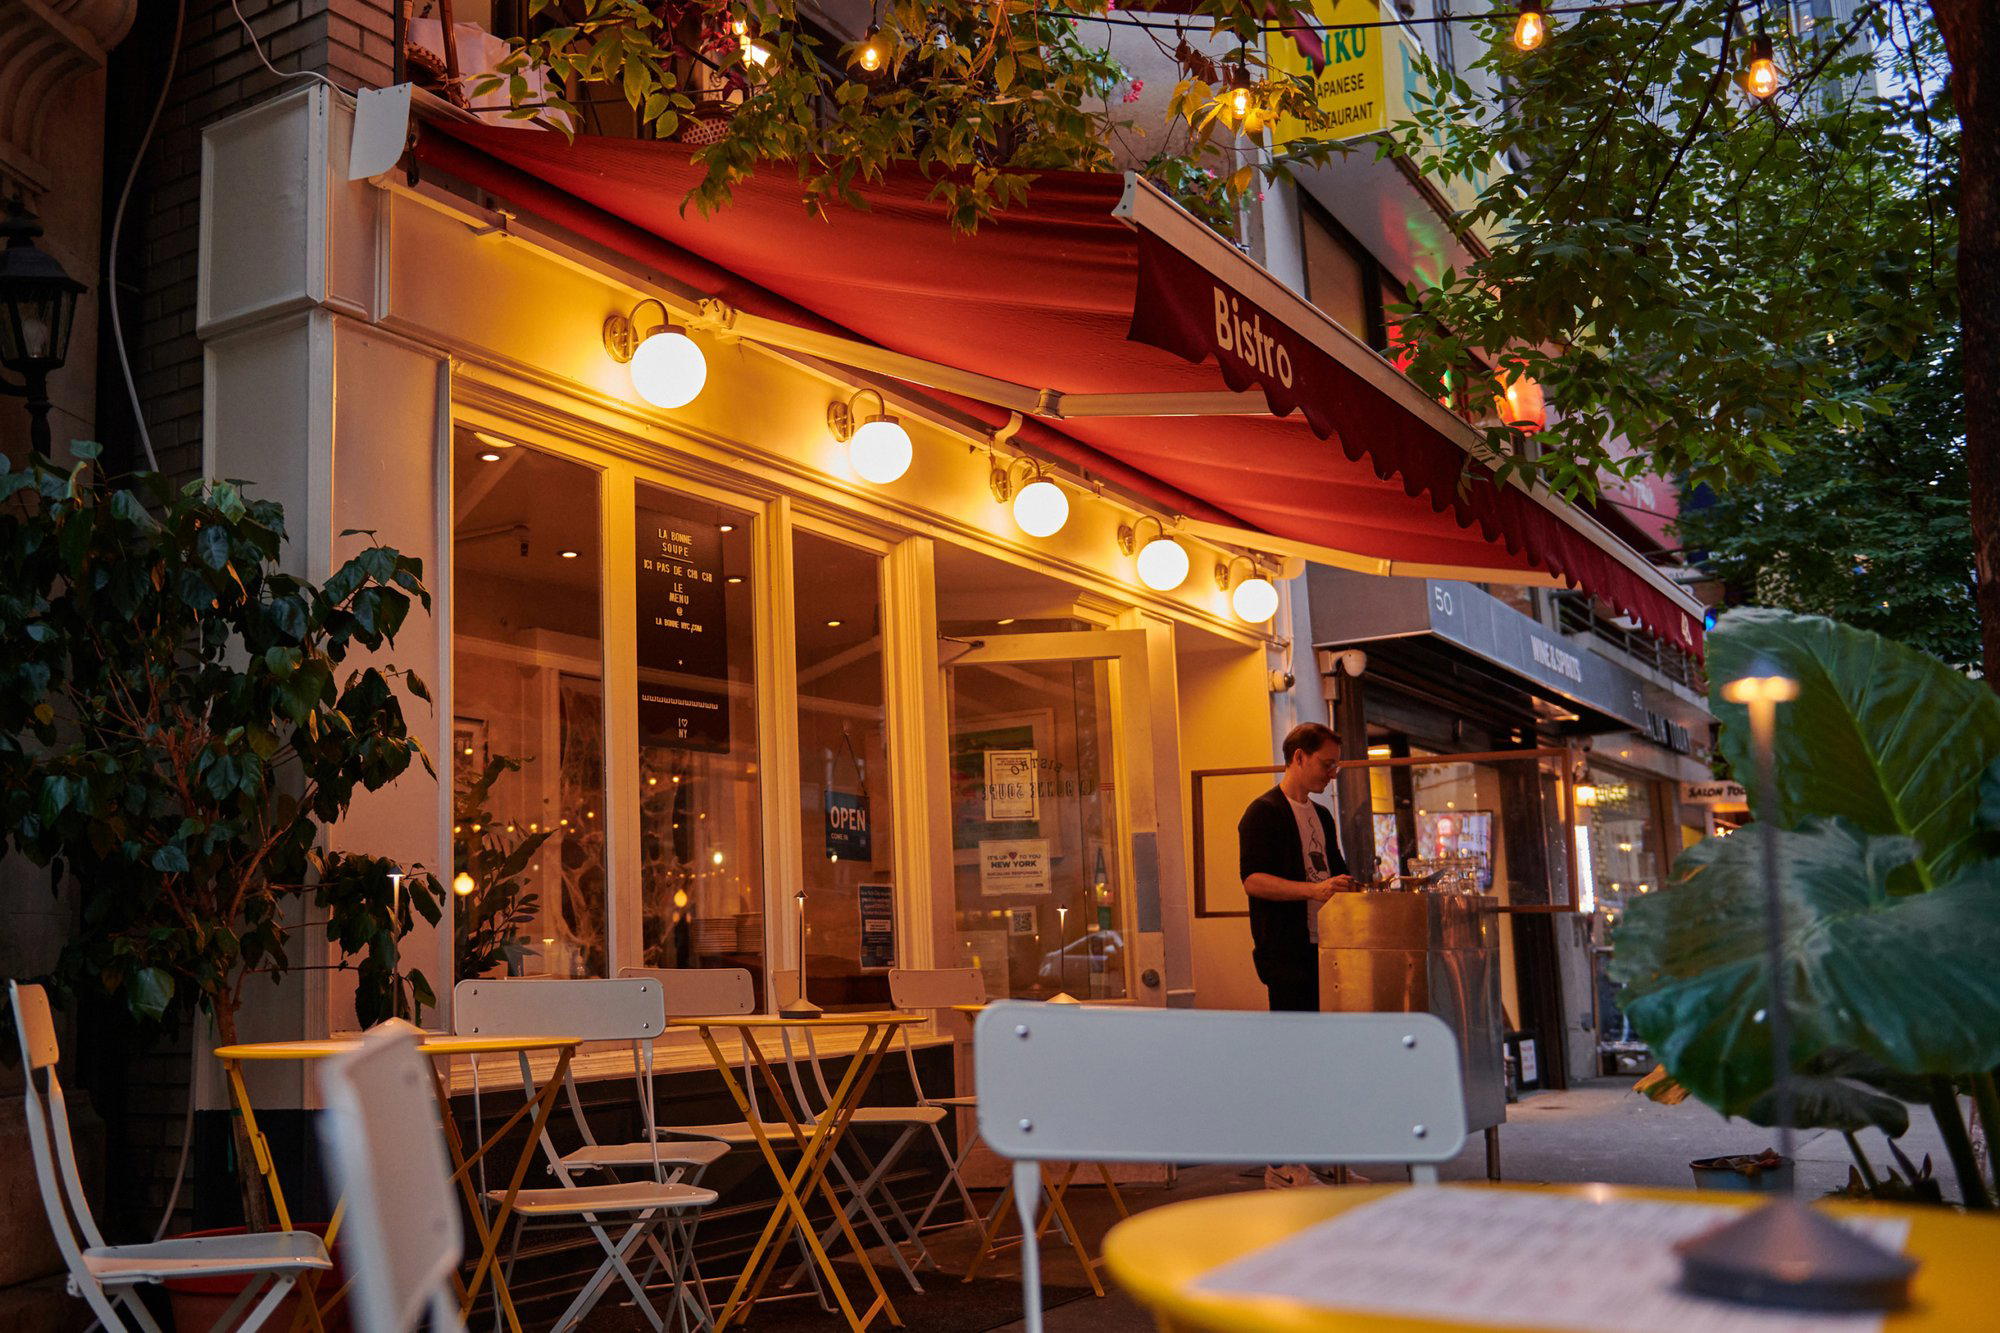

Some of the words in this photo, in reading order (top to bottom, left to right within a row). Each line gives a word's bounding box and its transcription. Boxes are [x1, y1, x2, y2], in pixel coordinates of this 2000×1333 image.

[1315, 72, 1365, 98] APANESE
[1213, 286, 1293, 389] Bistro
[658, 528, 668, 539] LA
[670, 531, 692, 545] BONNE
[662, 542, 689, 557] SOUPE
[656, 562, 670, 574] PAS
[673, 565, 682, 577] DE
[686, 568, 698, 579] CHI
[701, 572, 713, 583] CHI
[673, 582, 683, 593] LE
[669, 592, 689, 605] MENU
[1434, 586, 1453, 617] 50
[678, 728, 688, 738] NY
[1689, 786, 1723, 798] SALON
[831, 805, 866, 831] OPEN
